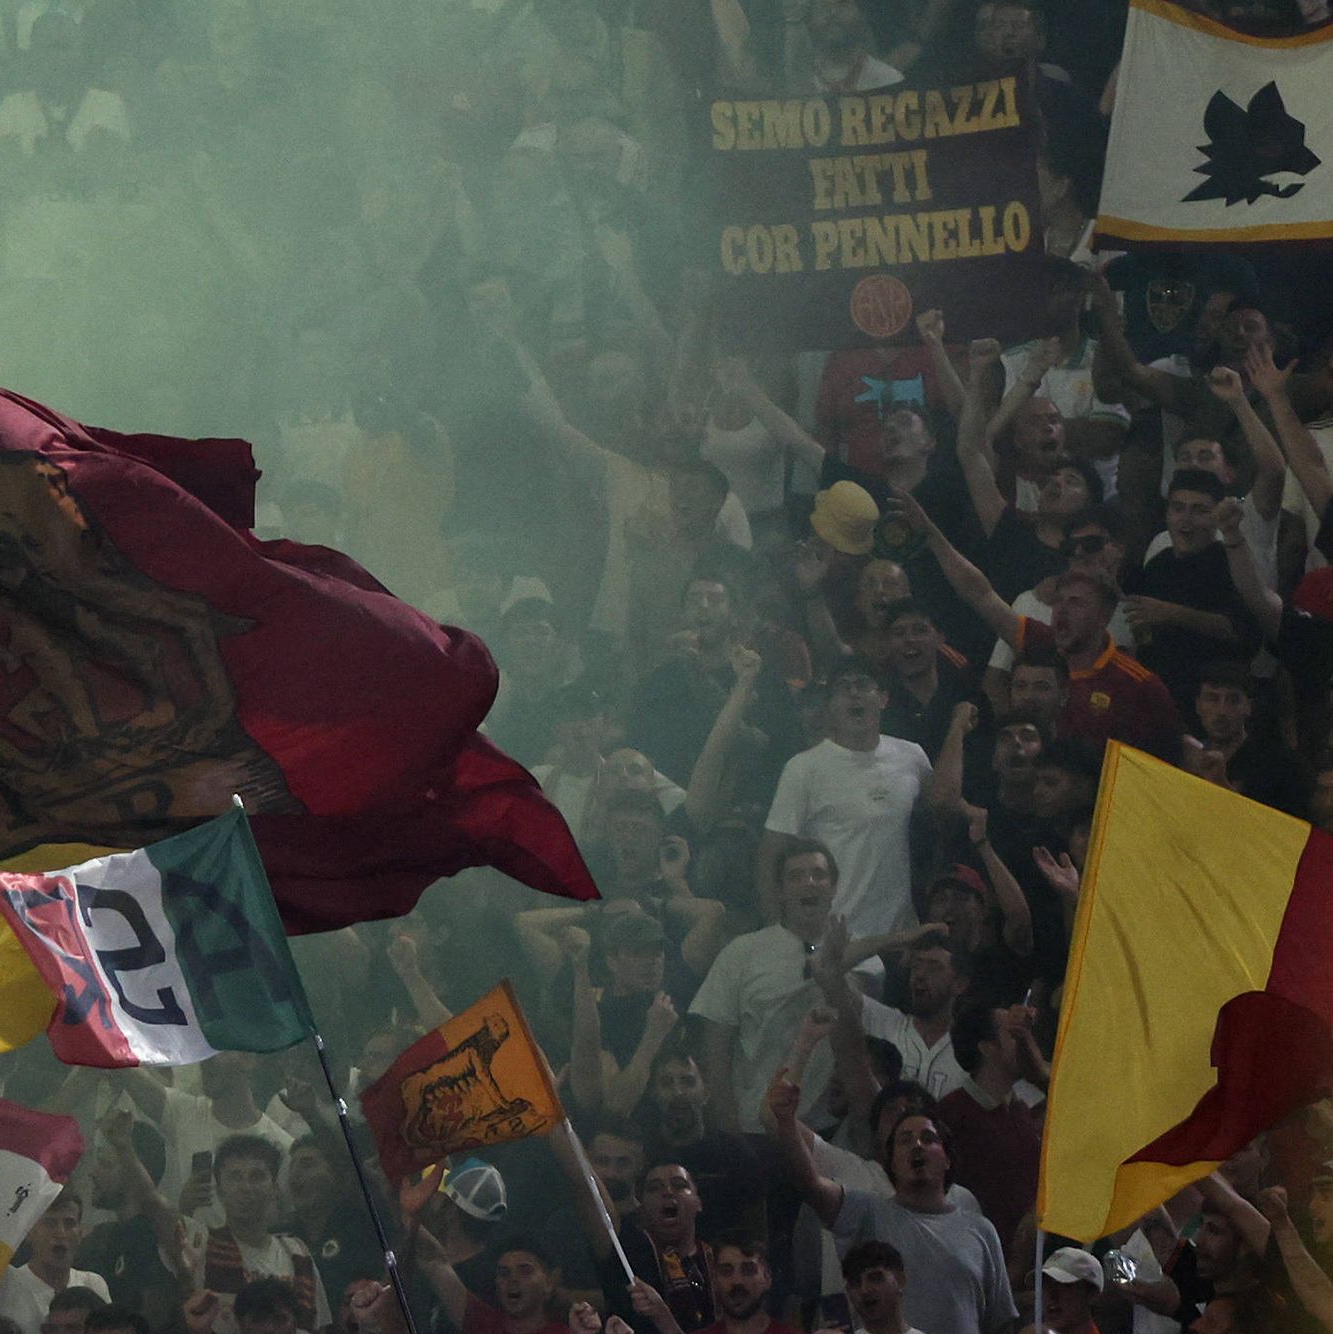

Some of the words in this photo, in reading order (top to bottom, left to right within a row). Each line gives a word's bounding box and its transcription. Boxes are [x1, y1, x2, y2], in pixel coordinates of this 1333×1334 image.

[710, 98, 831, 150] SEMO
[839, 76, 1021, 146] REGAZZI
[810, 149, 933, 210] FATTI
[720, 222, 803, 275] COR
[809, 200, 1031, 271] PENNELLO
